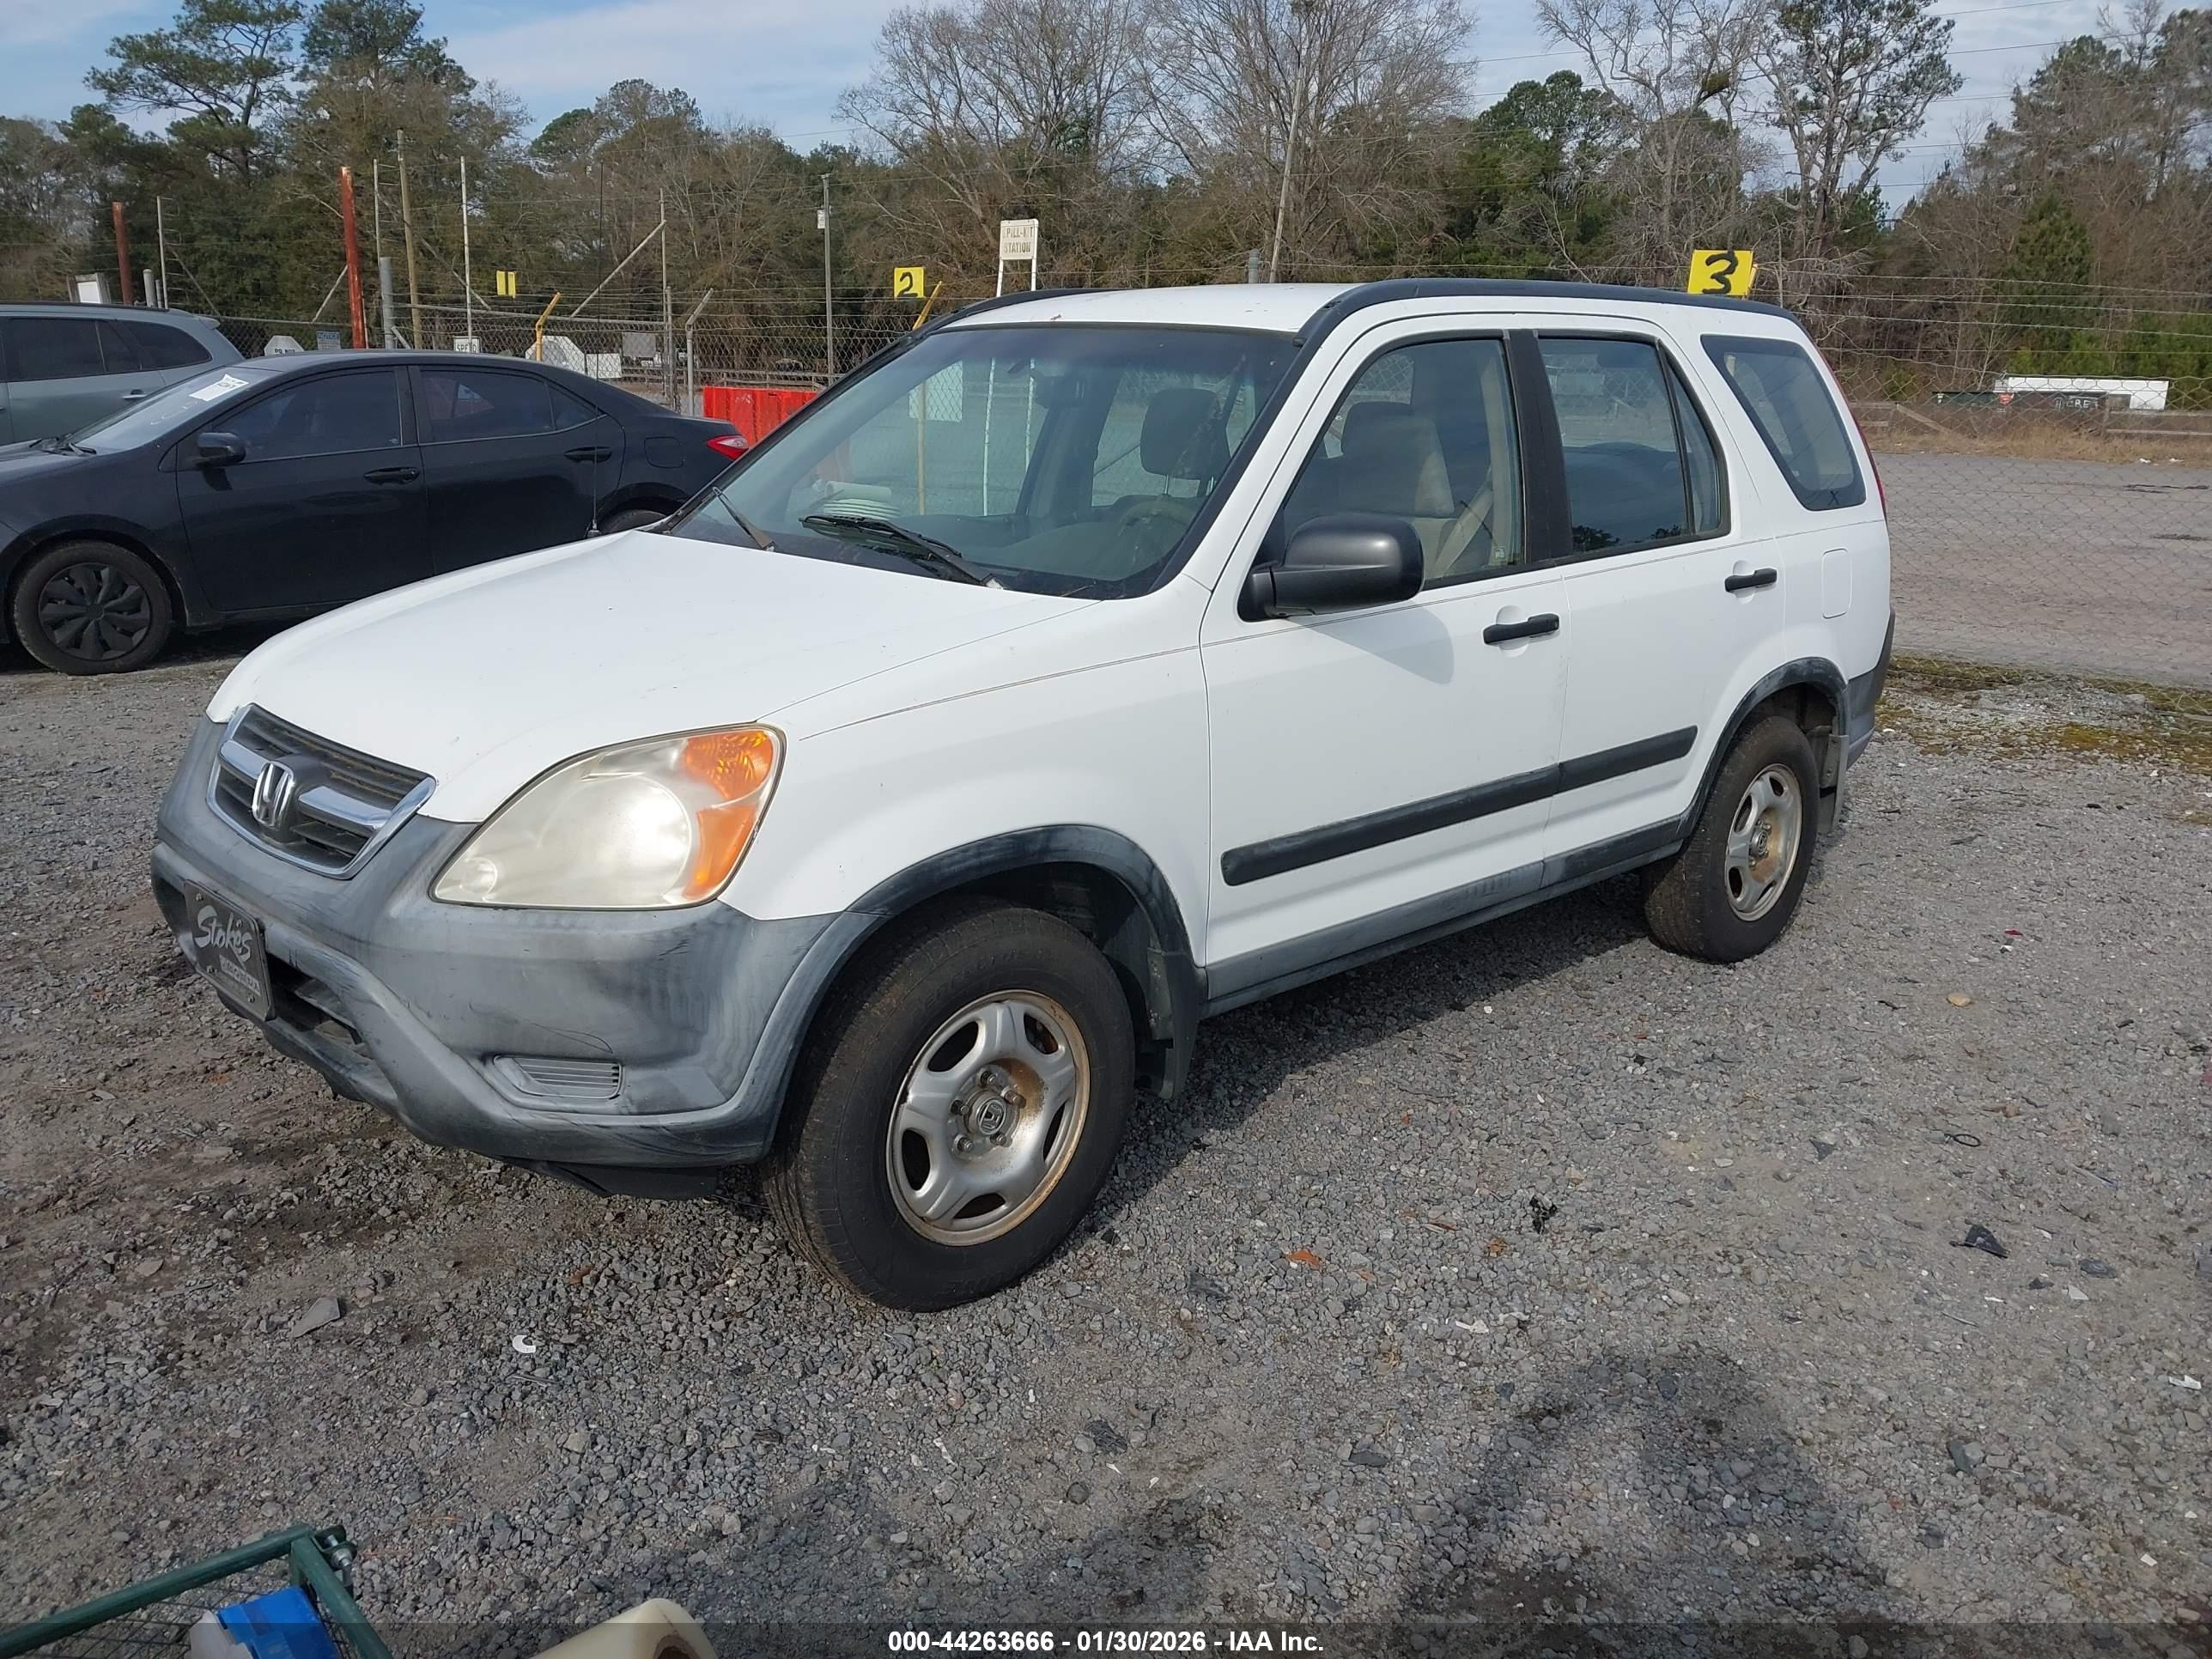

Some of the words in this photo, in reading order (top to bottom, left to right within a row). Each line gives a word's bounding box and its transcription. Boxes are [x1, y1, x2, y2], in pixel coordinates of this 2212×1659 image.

[1003, 241, 1031, 253] STATION
[897, 271, 918, 300] 2
[1702, 251, 1739, 294] 3
[456, 343, 477, 353] SPED
[194, 905, 252, 968] Stokes
